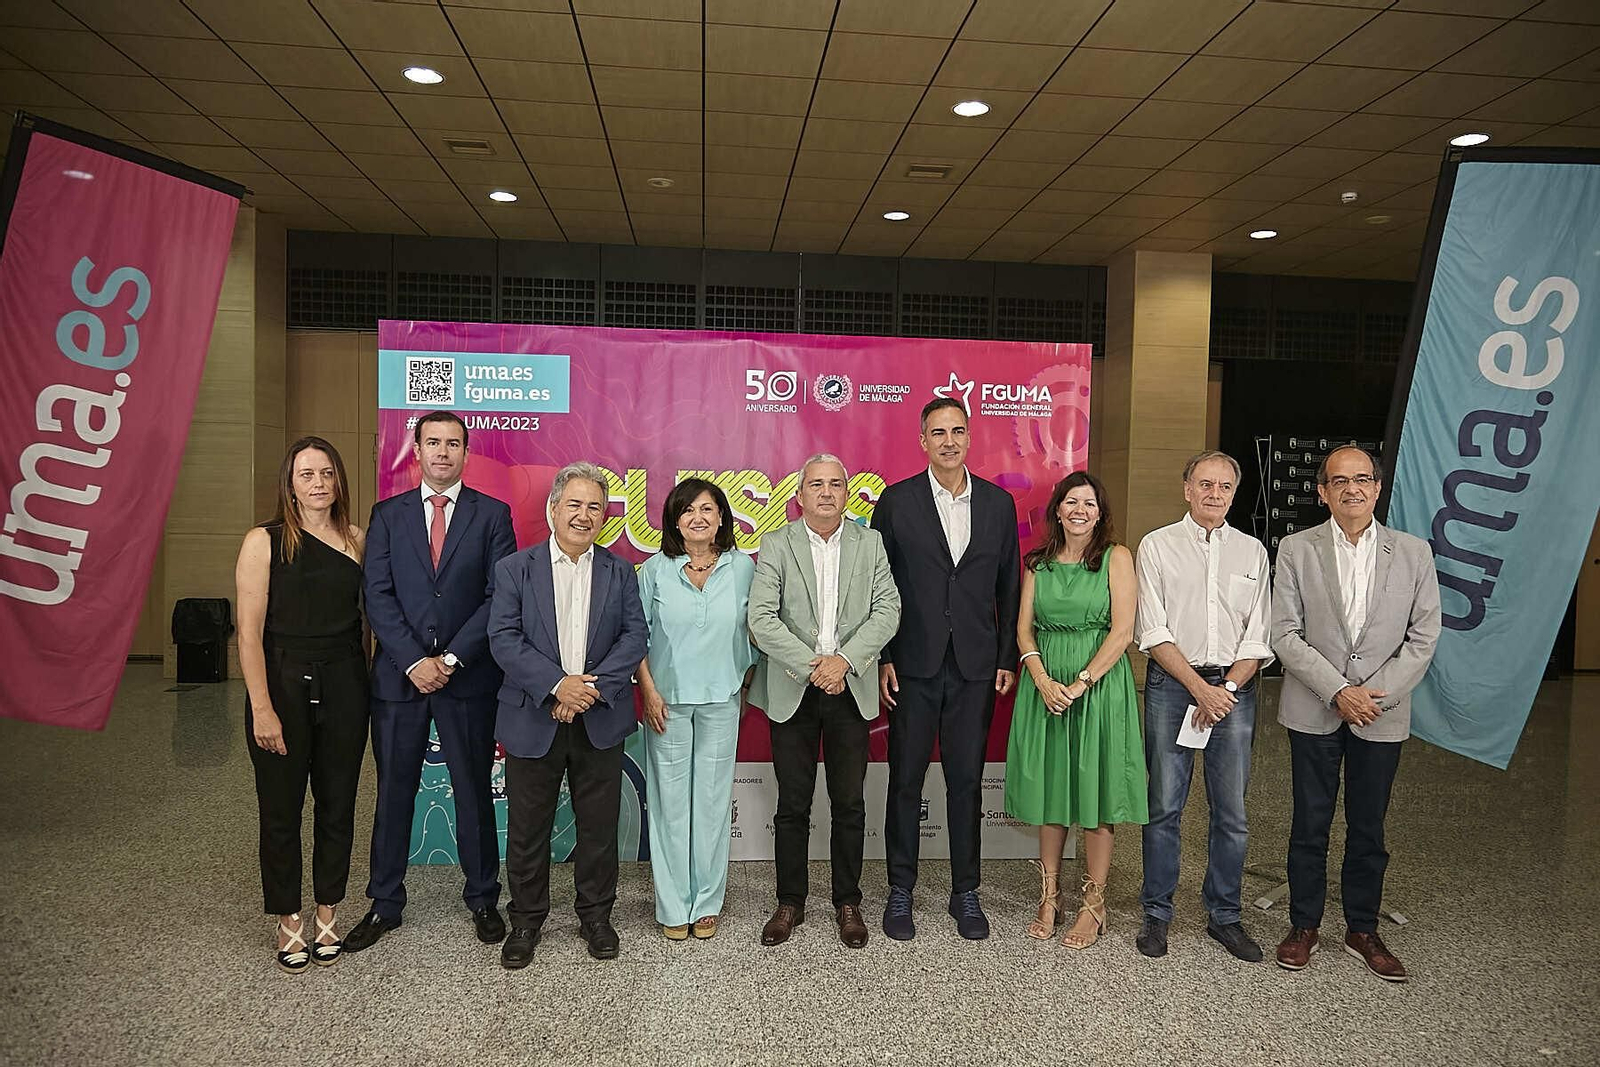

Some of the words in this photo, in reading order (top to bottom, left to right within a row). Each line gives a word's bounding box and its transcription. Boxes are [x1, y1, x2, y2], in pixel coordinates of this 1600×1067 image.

[464, 364, 533, 381] uma.es
[464, 382, 550, 404] fguma.es
[746, 370, 797, 401] 50
[859, 384, 911, 394] UNIVERSIDAD
[981, 383, 1053, 402] FGUMA
[859, 394, 870, 402] DE
[871, 393, 903, 403] MÁLAGA
[745, 404, 797, 413] ANIVERSARIO
[0, 256, 151, 606] uma.es
[1429, 275, 1580, 632] uma.es
